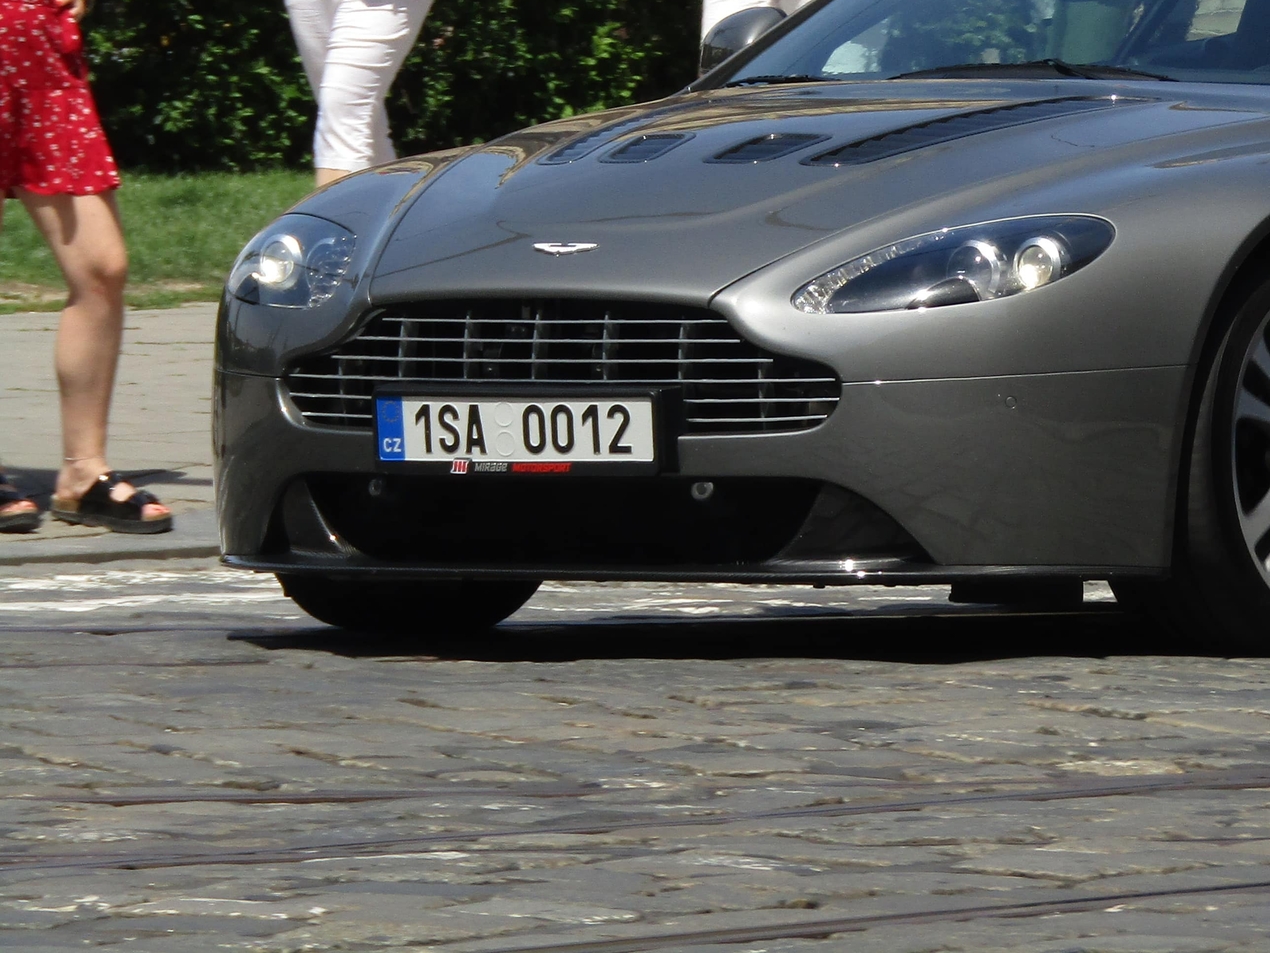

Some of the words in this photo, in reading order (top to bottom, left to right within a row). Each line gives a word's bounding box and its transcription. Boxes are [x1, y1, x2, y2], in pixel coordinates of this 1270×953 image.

[414, 404, 488, 455] 1SA
[522, 404, 633, 455] 0012
[383, 437, 403, 453] CZ
[511, 462, 572, 473] MOTORSPORT
